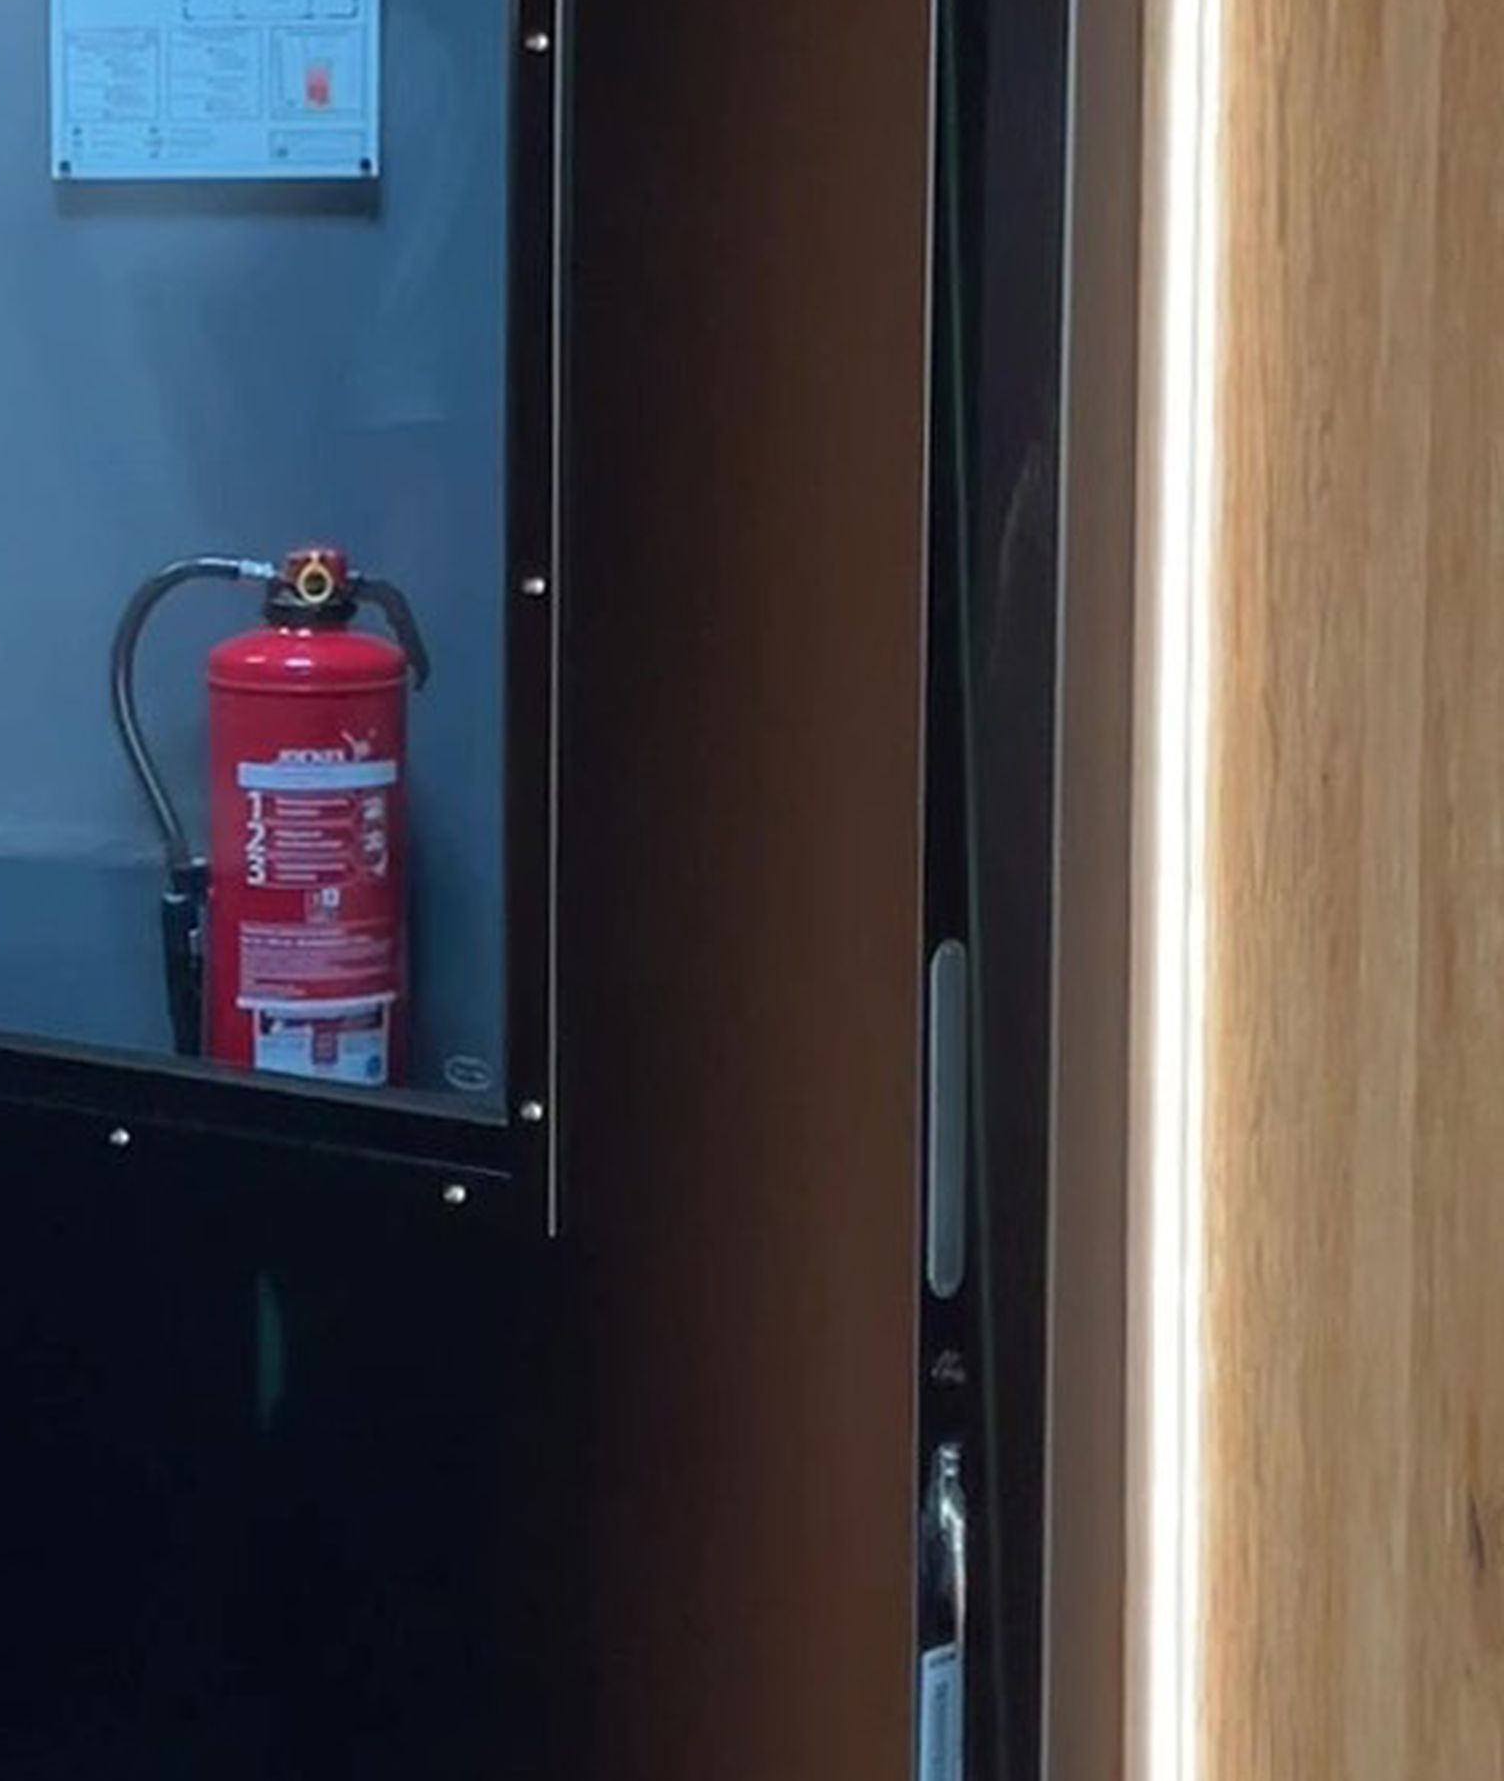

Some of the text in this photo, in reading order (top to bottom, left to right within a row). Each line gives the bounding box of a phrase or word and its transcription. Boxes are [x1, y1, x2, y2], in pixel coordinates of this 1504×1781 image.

[248, 791, 262, 821] 1
[245, 822, 265, 853] 2
[247, 853, 266, 885] 3
